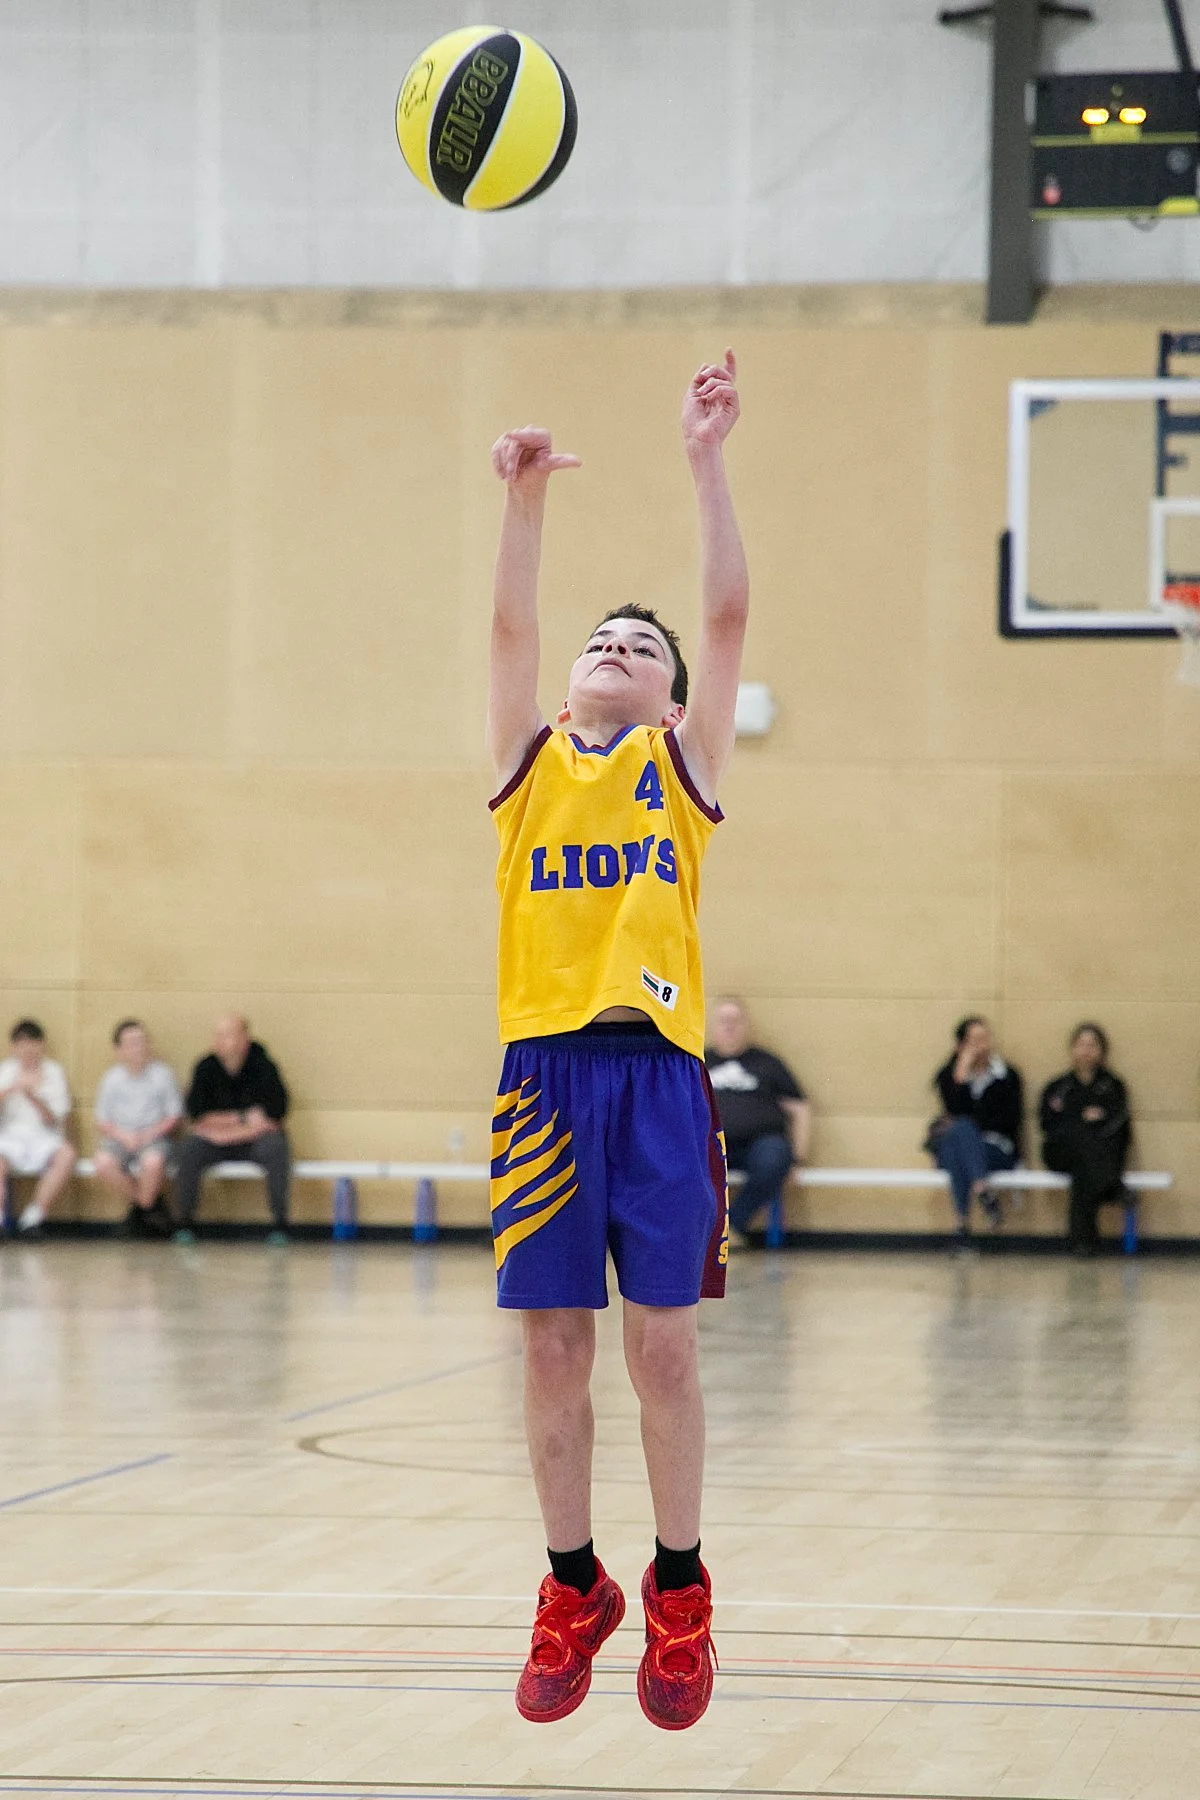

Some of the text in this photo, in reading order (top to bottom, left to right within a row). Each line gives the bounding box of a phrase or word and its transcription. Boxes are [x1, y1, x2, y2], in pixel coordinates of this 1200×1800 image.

[634, 760, 664, 811] 4
[530, 834, 678, 892] LIONS
[662, 986, 673, 1003] 8
